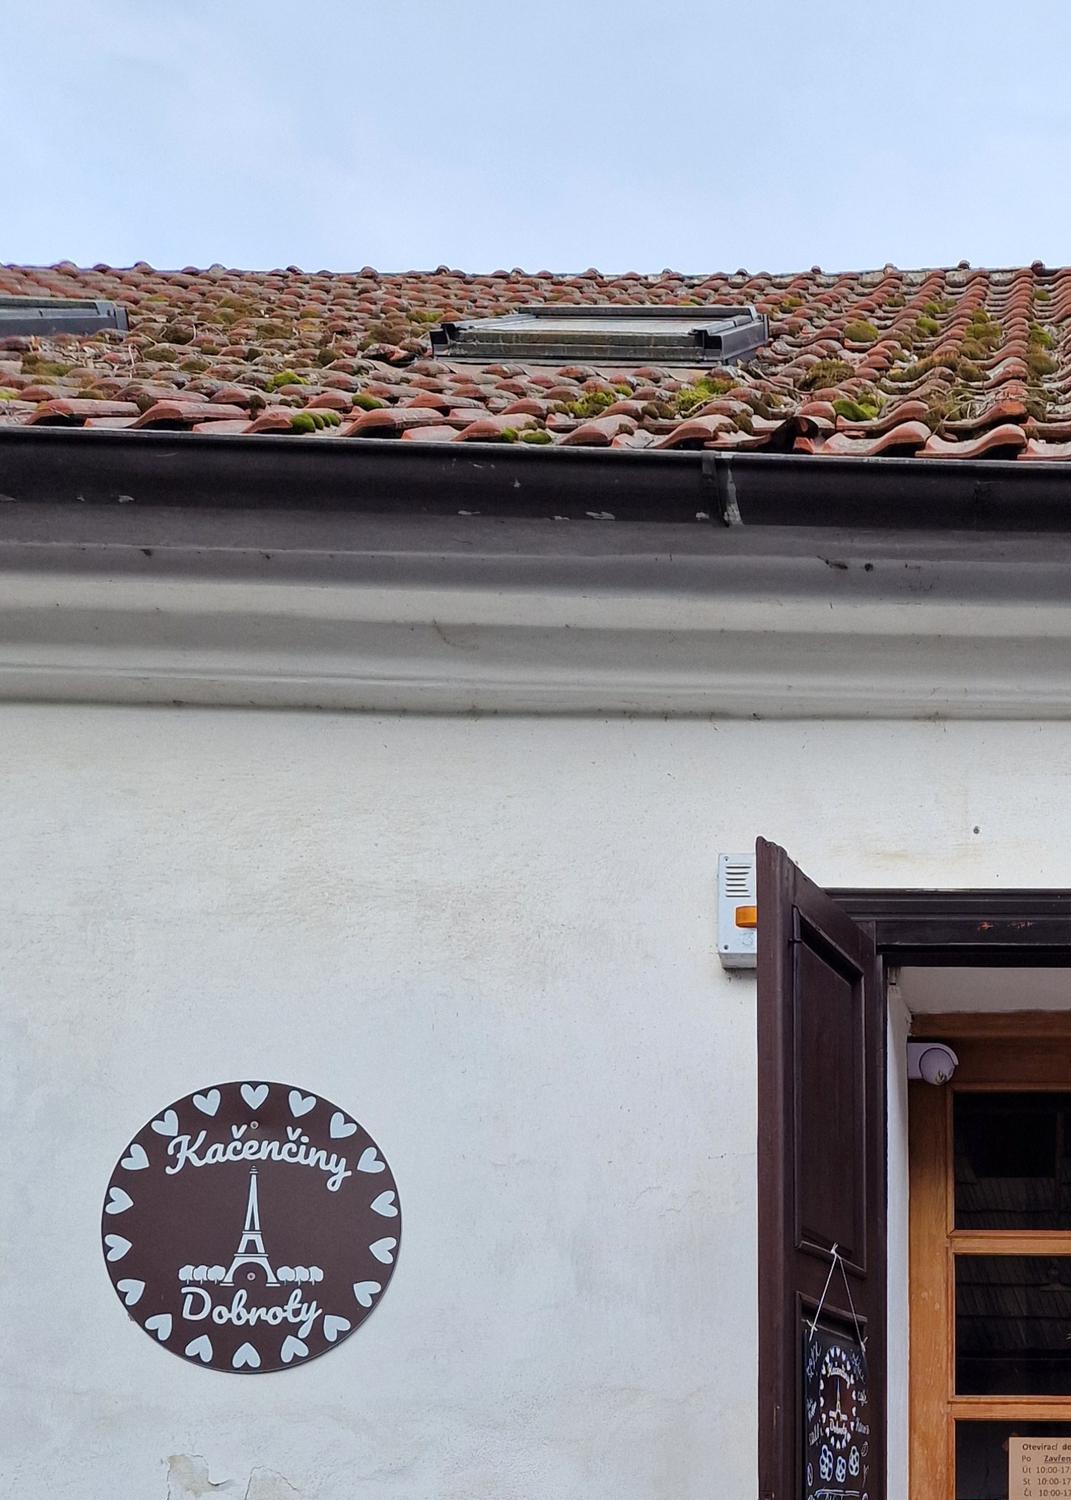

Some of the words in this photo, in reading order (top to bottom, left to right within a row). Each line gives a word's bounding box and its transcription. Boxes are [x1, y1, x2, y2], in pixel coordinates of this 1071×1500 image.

[165, 1124, 352, 1192] Kačenčiny
[180, 1286, 323, 1338] Dobroty
[1023, 1477, 1031, 1486] St
